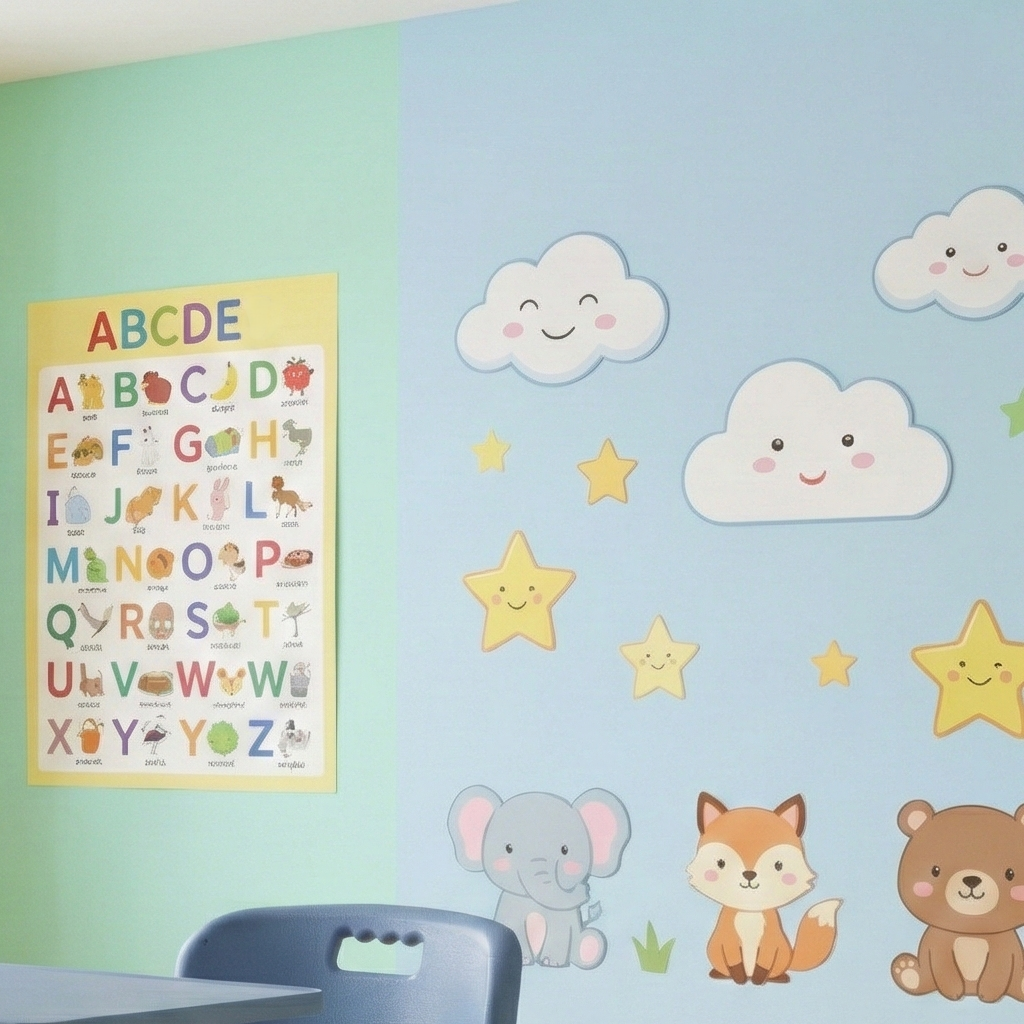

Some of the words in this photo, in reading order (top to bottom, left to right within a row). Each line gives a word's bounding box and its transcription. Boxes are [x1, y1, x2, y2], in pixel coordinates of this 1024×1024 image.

[87, 299, 241, 352] ABCDE
[47, 376, 74, 413] A
[114, 372, 139, 408] B
[180, 365, 207, 403] C
[249, 360, 277, 398] D
[47, 433, 68, 469] E
[112, 429, 132, 466] F
[174, 424, 203, 463] G
[250, 420, 277, 459] H
[47, 490, 59, 526] I
[104, 487, 121, 524] J
[173, 484, 198, 521] K
[246, 481, 267, 519] L
[47, 547, 79, 583] M
[116, 545, 142, 582] N
[182, 542, 213, 581] O
[256, 540, 281, 578] P
[46, 603, 77, 650] Q
[121, 603, 145, 640] R
[186, 602, 210, 639] S
[254, 601, 279, 639] T
[47, 661, 73, 698] U
[111, 661, 138, 698] V
[176, 661, 216, 698] W
[247, 661, 288, 698] W
[47, 719, 73, 755] X
[112, 719, 139, 756] Y
[179, 719, 207, 756] Y
[248, 720, 274, 757] Z
